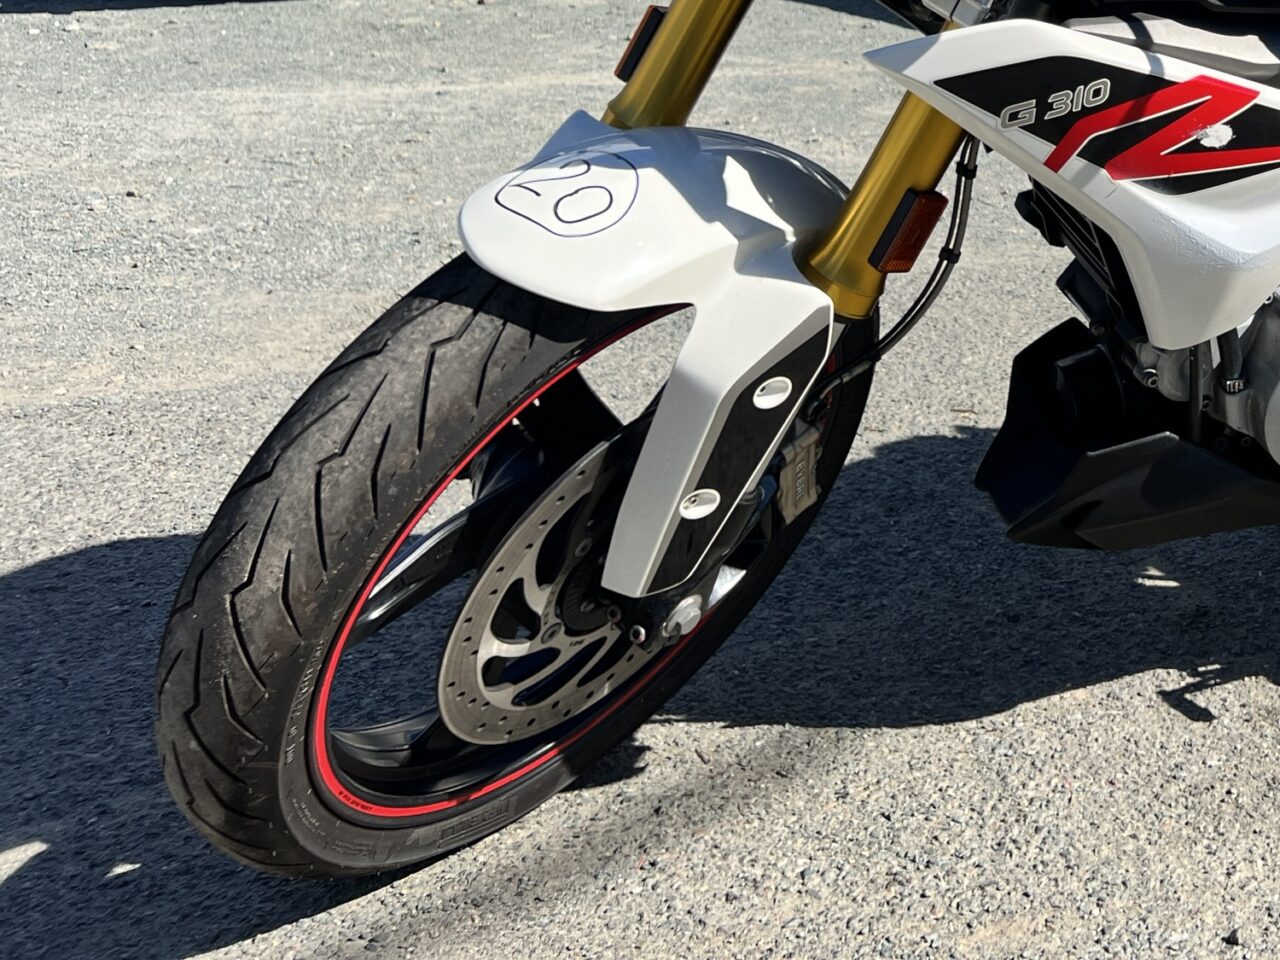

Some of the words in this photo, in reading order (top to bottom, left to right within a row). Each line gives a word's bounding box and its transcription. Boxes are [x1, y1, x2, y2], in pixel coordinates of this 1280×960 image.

[1000, 98, 1037, 130] G
[1045, 78, 1112, 119] 310
[507, 158, 613, 224] 20
